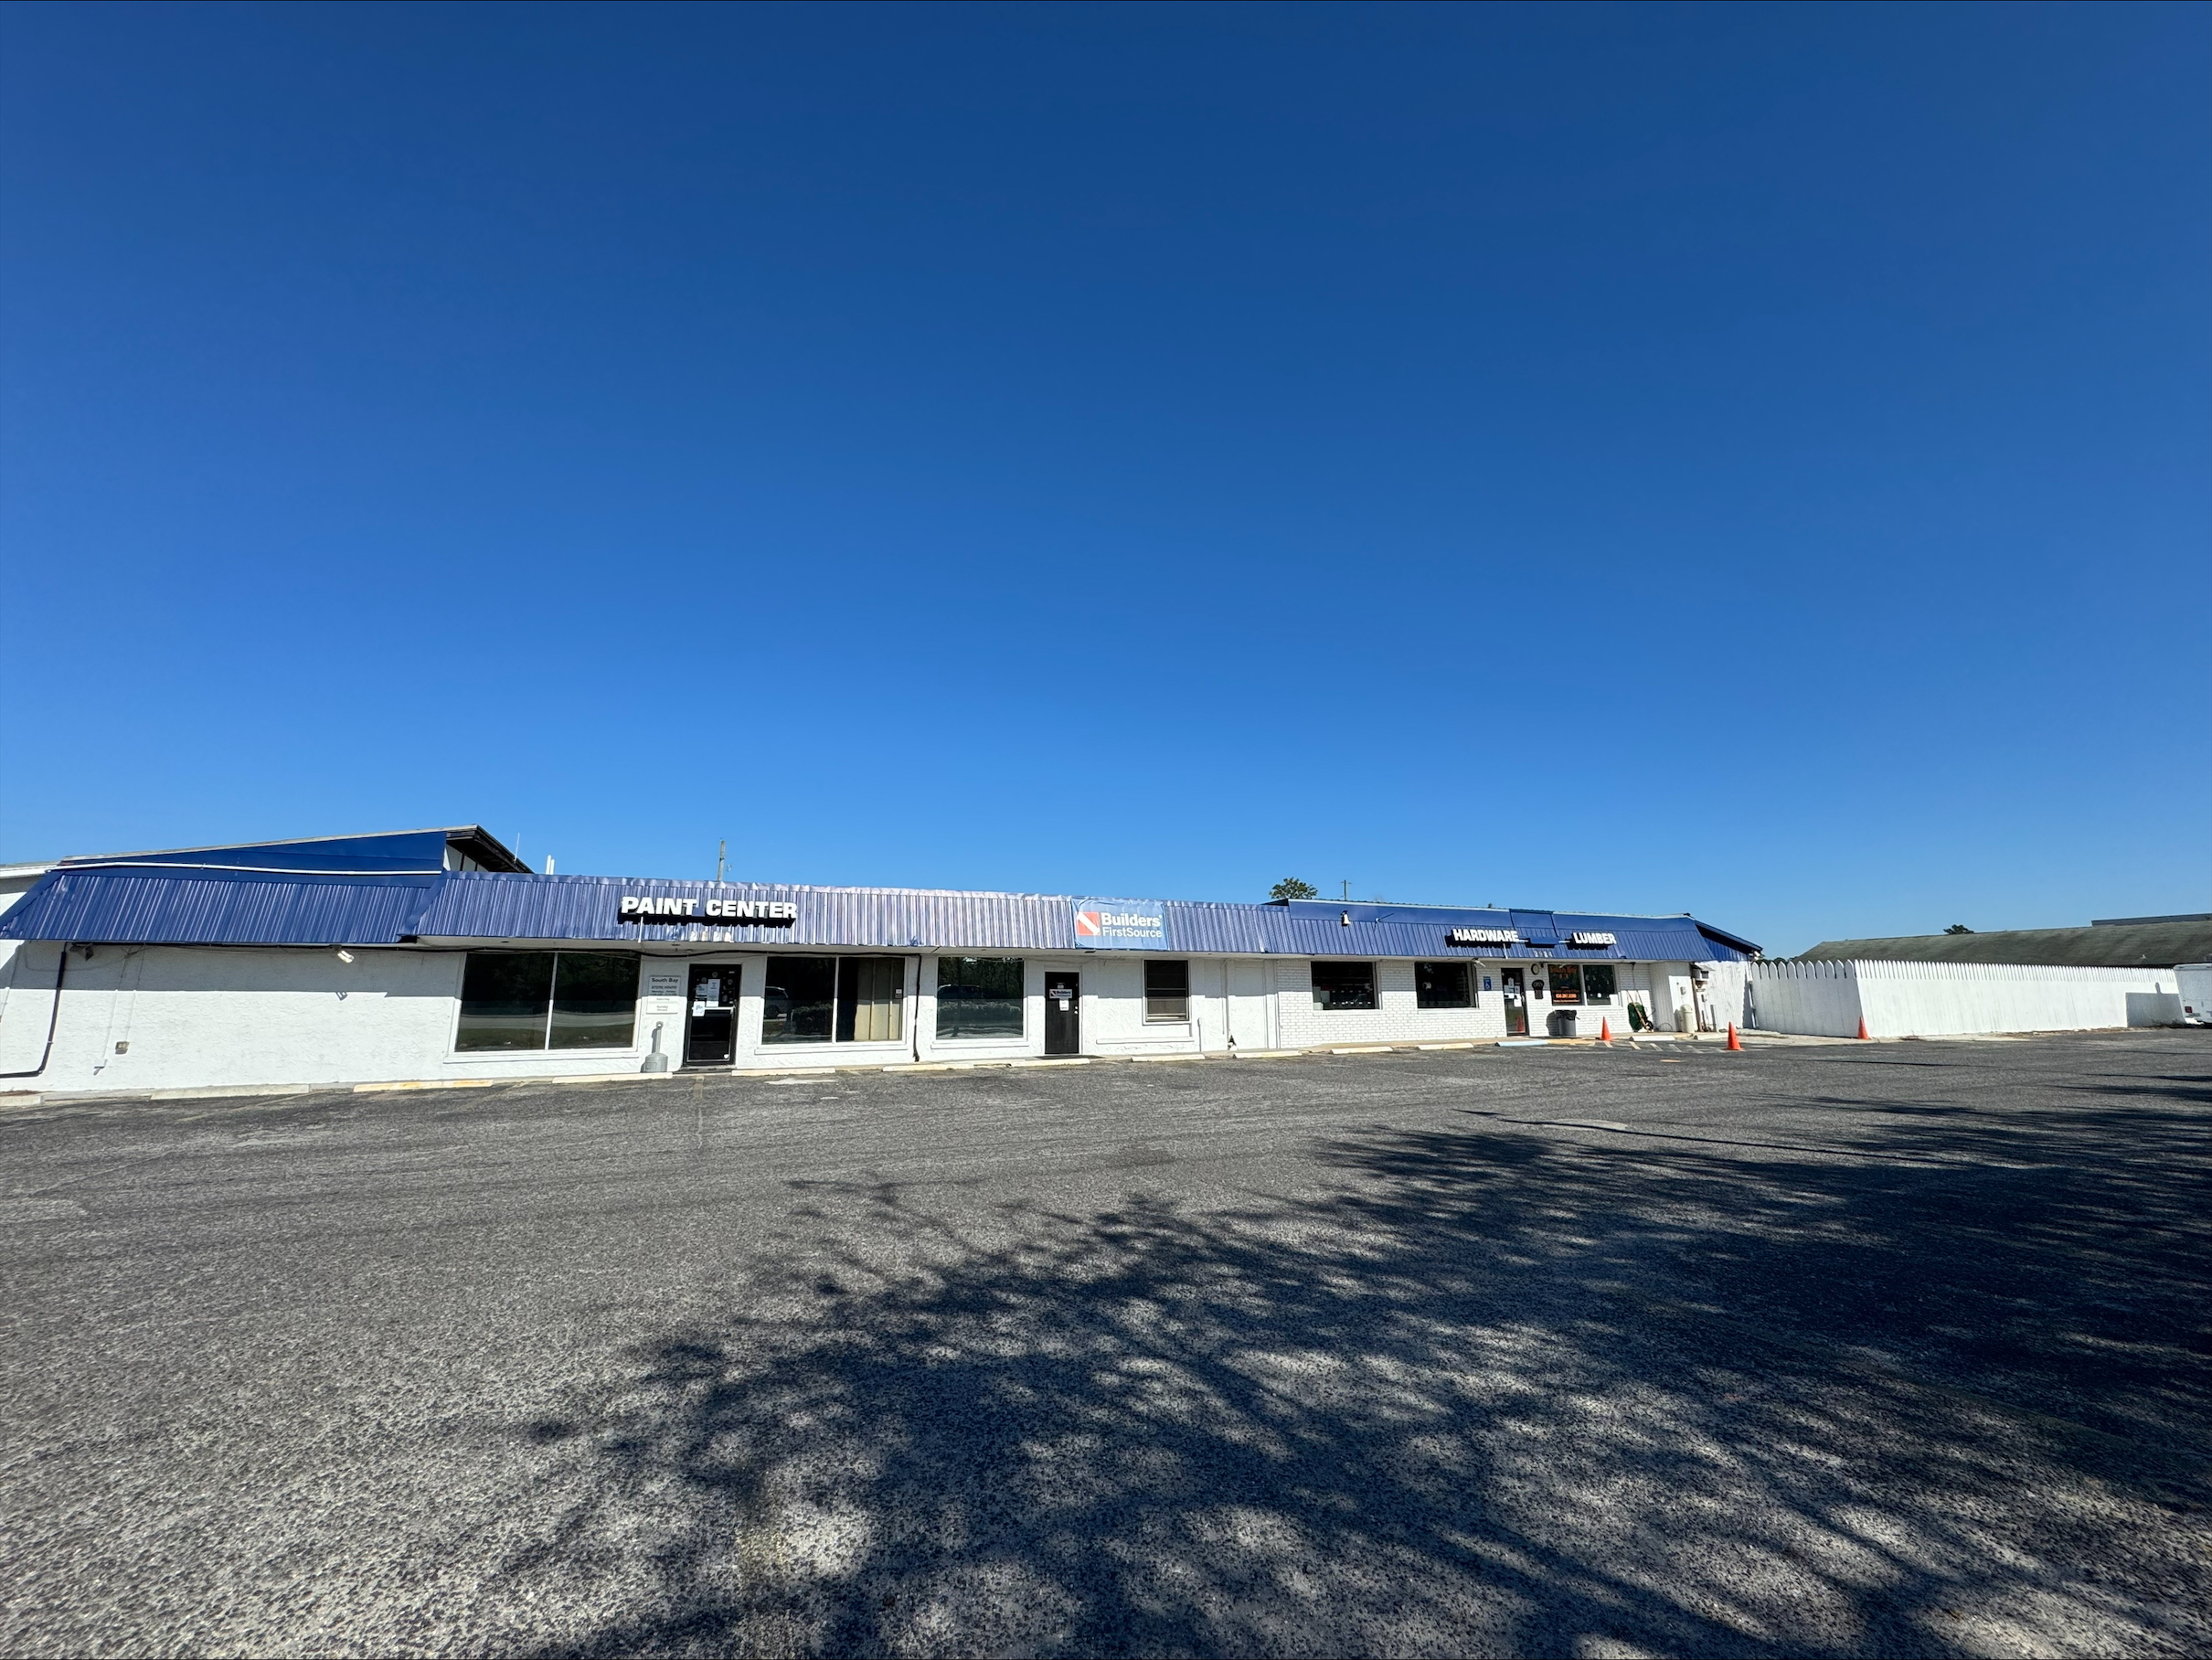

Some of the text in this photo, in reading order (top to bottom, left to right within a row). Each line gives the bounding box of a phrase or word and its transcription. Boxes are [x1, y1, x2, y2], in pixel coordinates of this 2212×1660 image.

[622, 897, 797, 919] PAINT CENTER
[1101, 912, 1161, 926] Builders
[1102, 927, 1162, 938] FirstSource
[1452, 929, 1519, 942] HARDWARE
[1573, 932, 1616, 944] LUMBER
